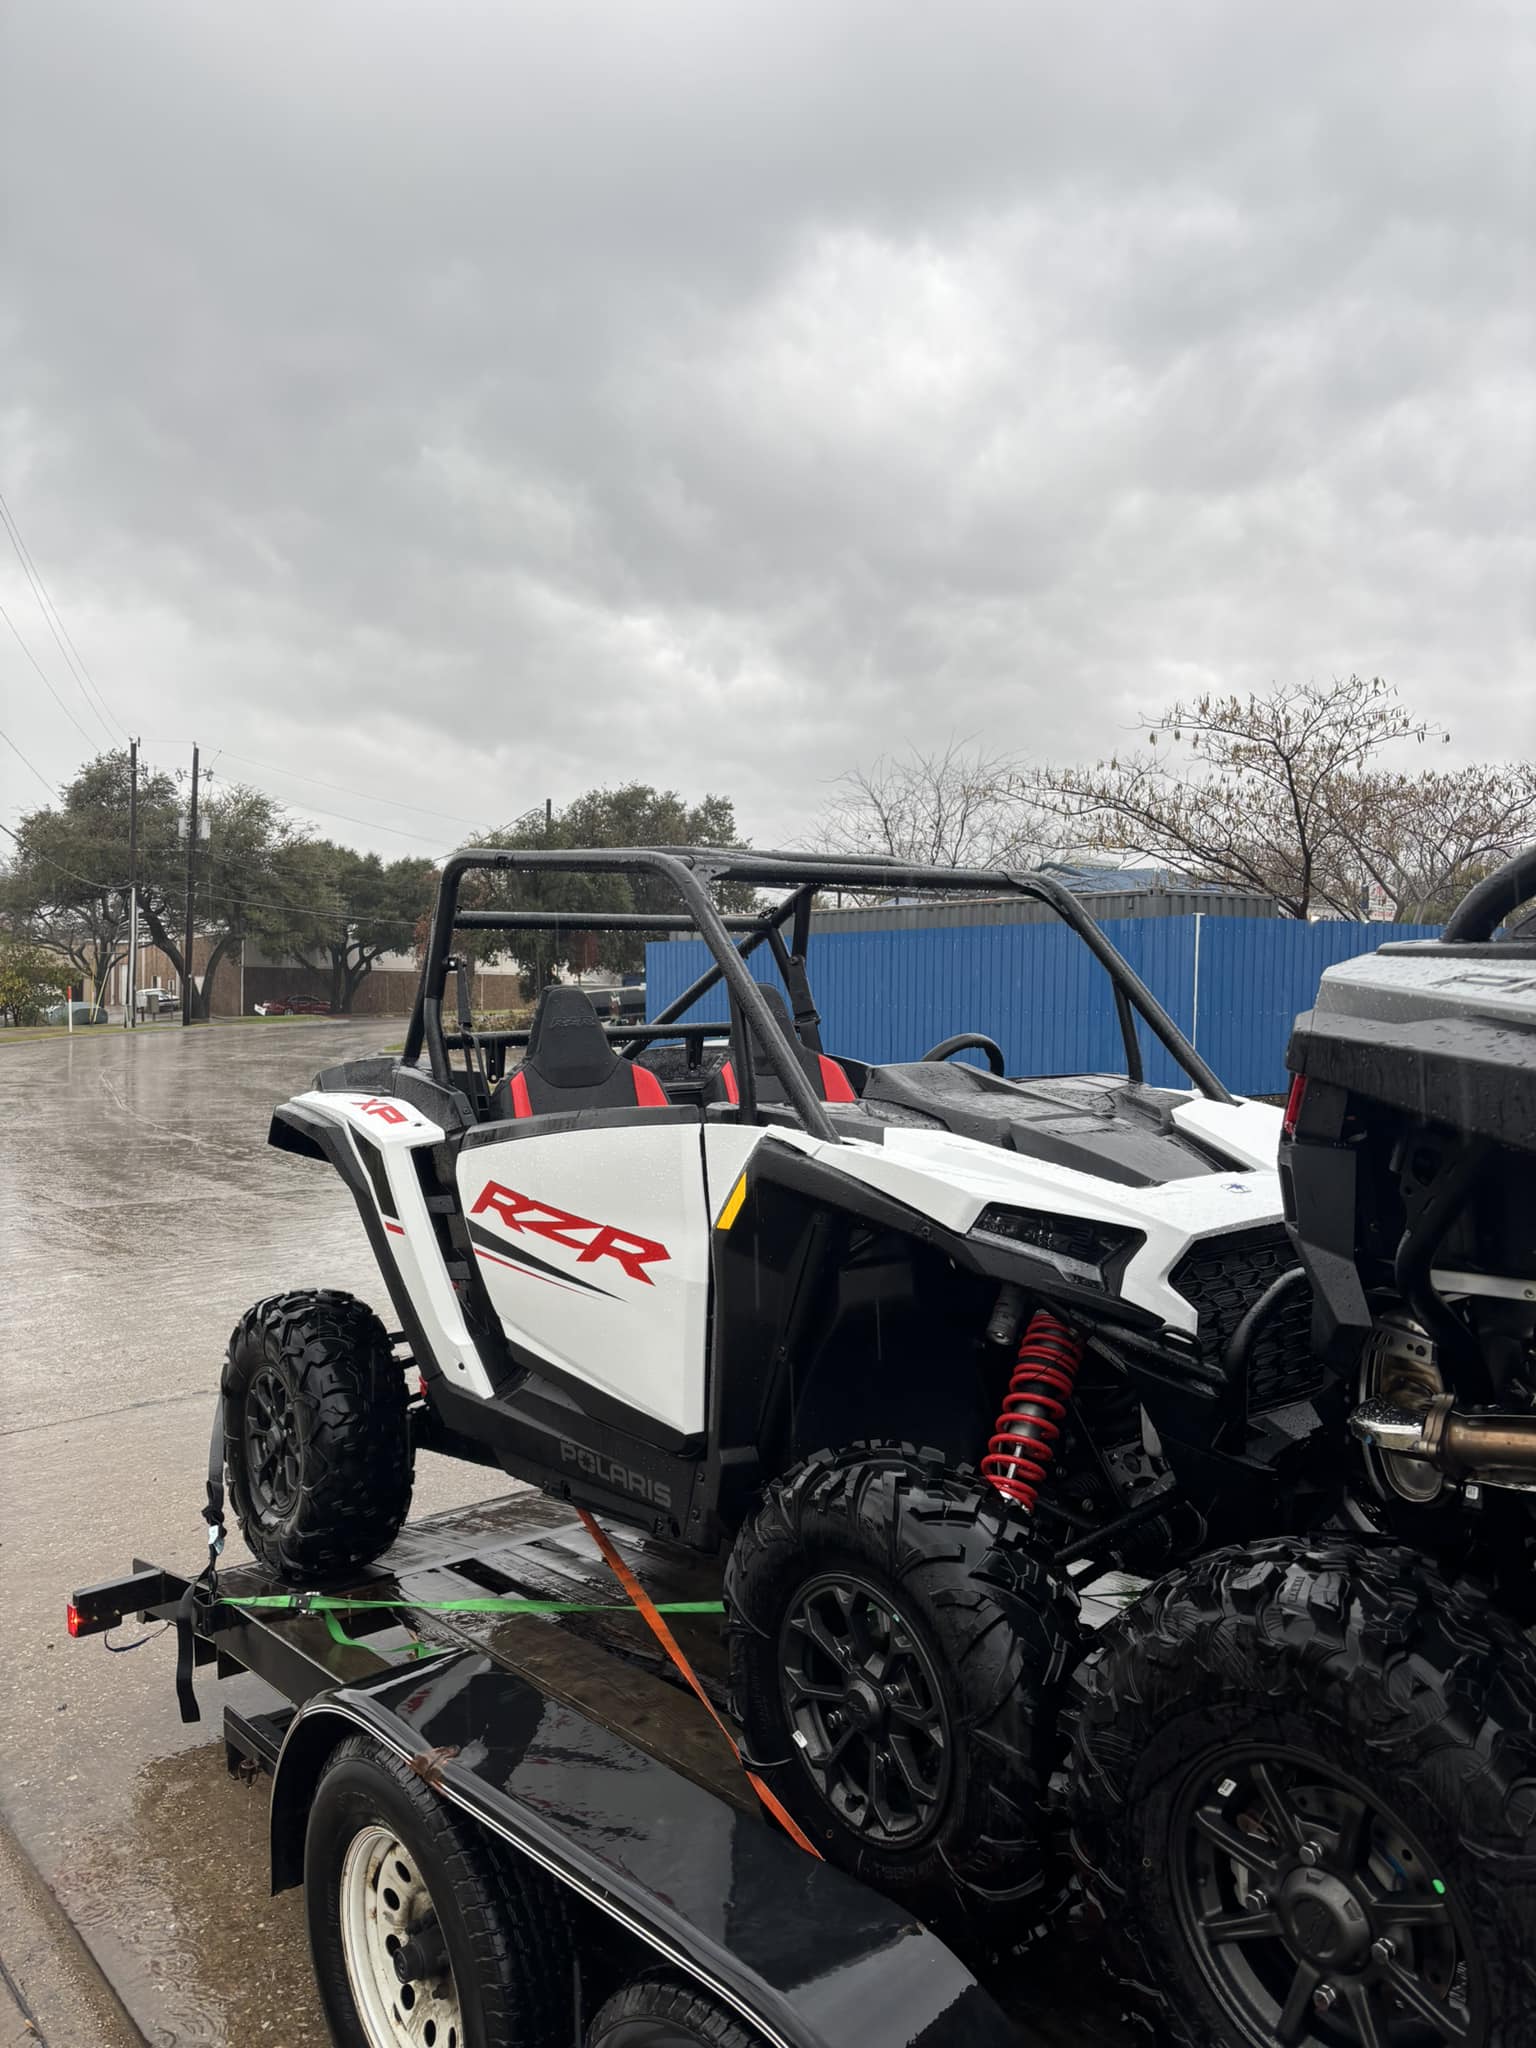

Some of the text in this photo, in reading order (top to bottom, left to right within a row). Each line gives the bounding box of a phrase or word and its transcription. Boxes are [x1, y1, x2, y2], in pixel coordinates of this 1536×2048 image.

[350, 1098, 408, 1124] XP
[470, 1180, 671, 1286] RZR
[560, 1441, 671, 1508] POLARIS
